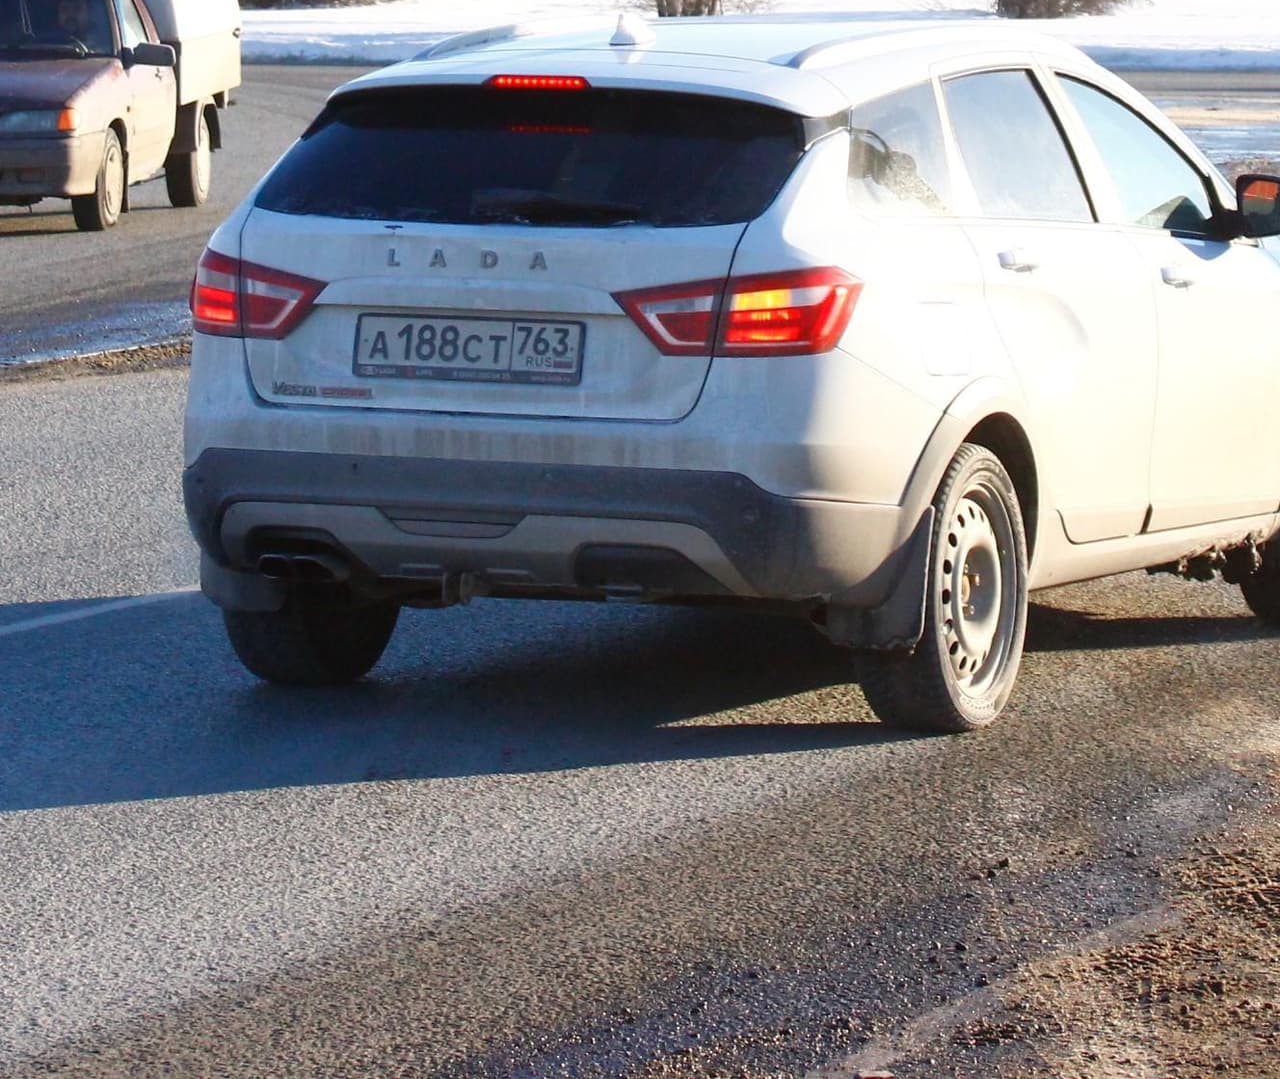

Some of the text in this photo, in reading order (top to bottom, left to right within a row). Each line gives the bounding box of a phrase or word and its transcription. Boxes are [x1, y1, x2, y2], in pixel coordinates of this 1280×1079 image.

[387, 248, 548, 270] LADA
[369, 323, 570, 364] А188СТ 763
[525, 356, 552, 368] RUS
